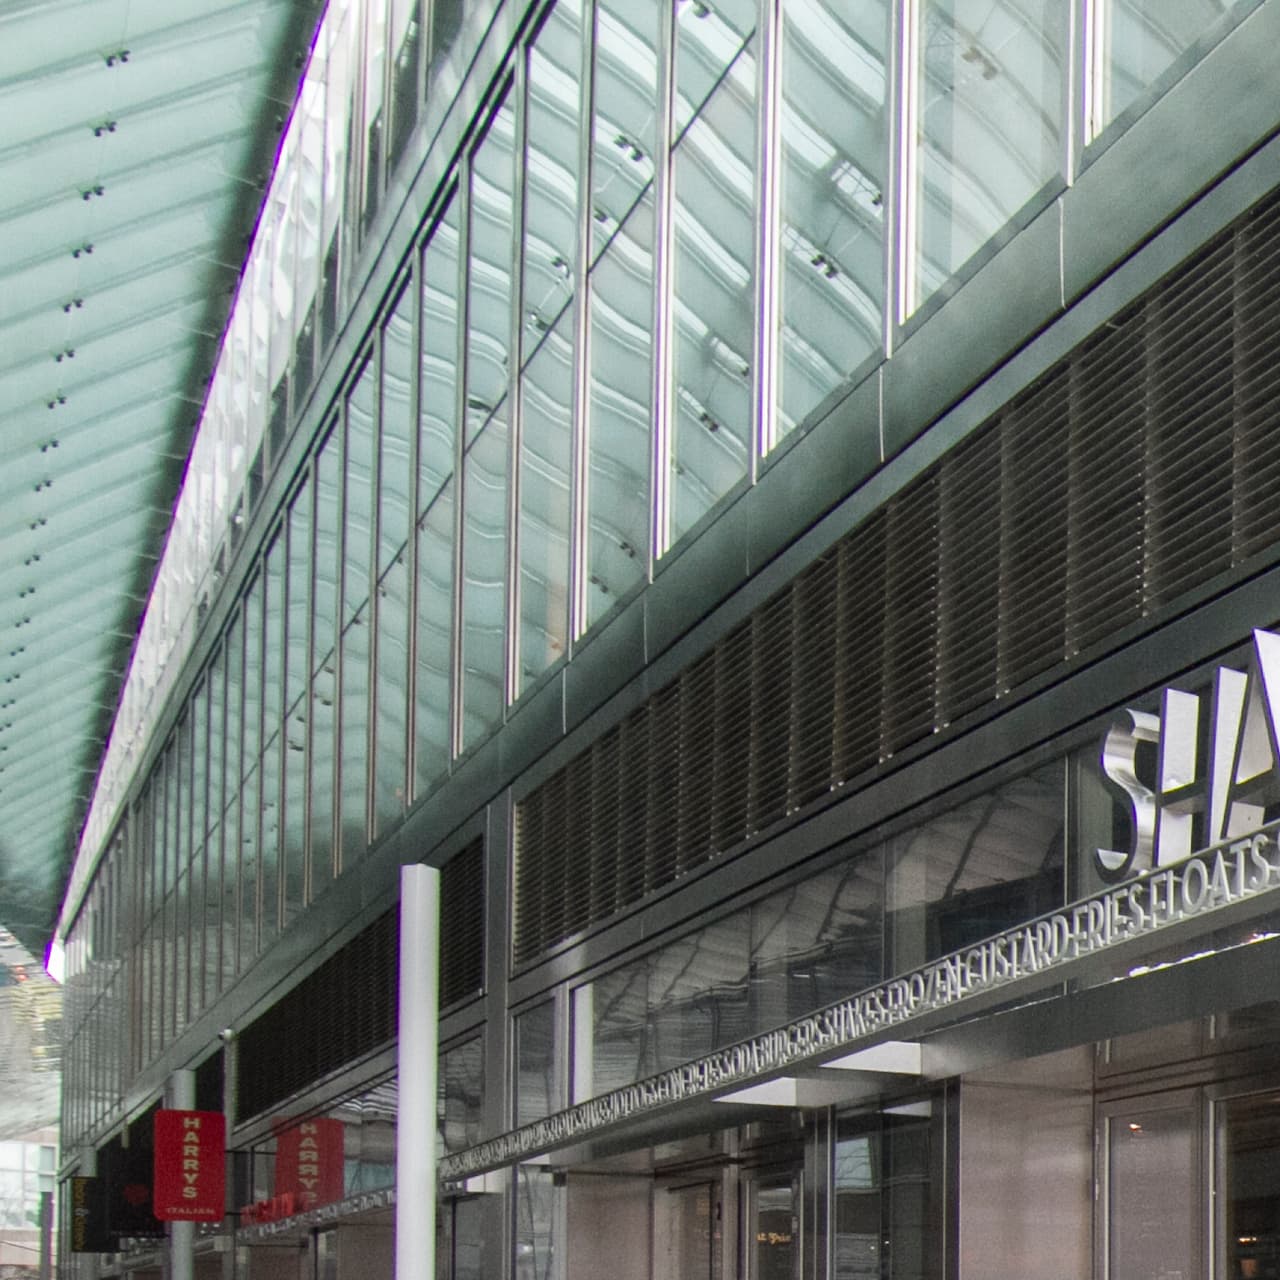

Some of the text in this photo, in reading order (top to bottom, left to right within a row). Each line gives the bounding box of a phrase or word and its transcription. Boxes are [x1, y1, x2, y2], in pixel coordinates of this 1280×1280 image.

[721, 1039, 759, 1077] SODA
[757, 1016, 824, 1067] BURGERS
[823, 988, 887, 1041] SHAKES
[887, 953, 962, 1021] FROZEN
[964, 914, 1070, 989] CUSTARD
[1074, 882, 1146, 957] FRIES
[1150, 833, 1271, 928] FLOATS
[183, 1117, 200, 1198] HARRYS
